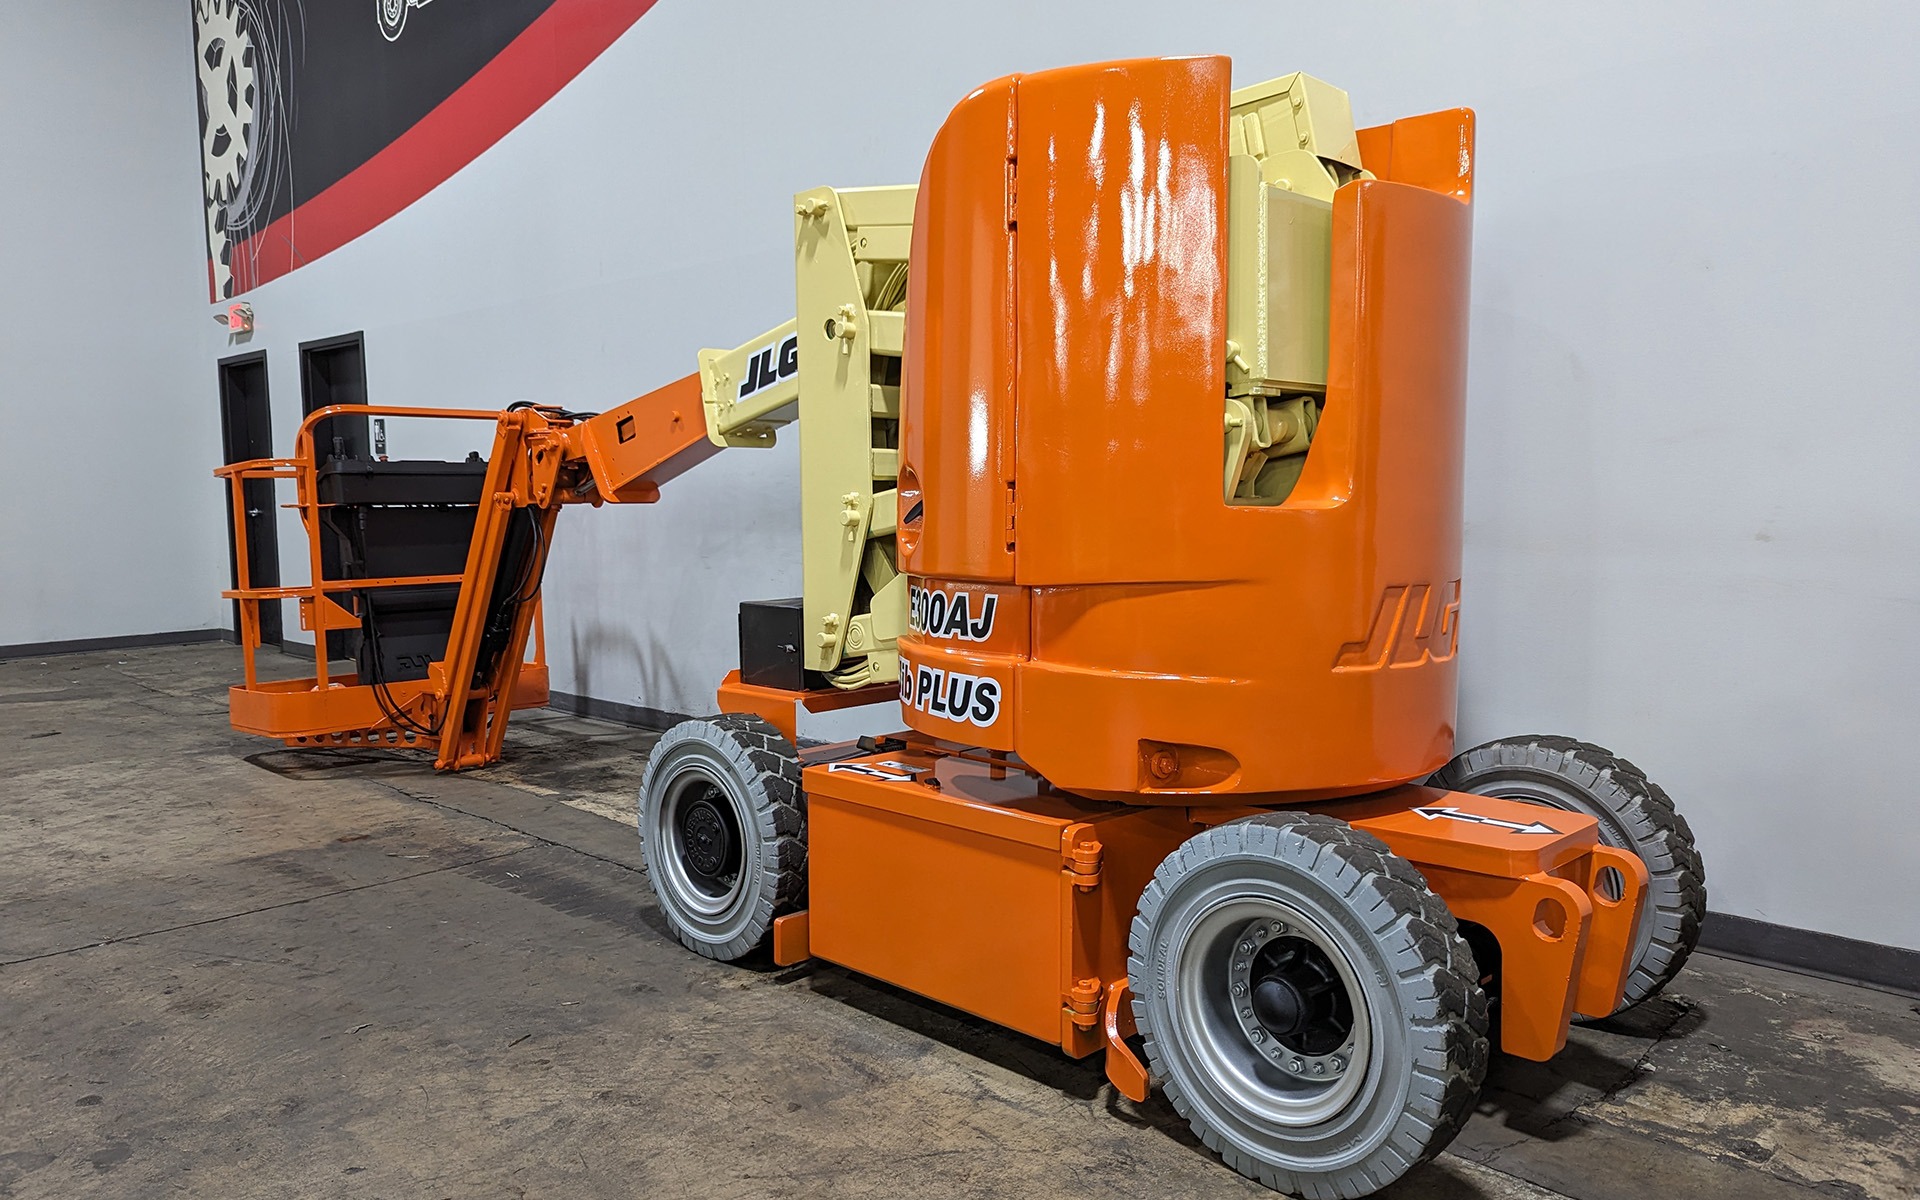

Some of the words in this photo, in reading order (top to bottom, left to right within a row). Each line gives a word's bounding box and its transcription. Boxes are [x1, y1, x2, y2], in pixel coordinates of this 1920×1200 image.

[738, 335, 798, 400] JLG
[1331, 577, 1461, 673] JLG
[916, 668, 999, 724] PLUS
